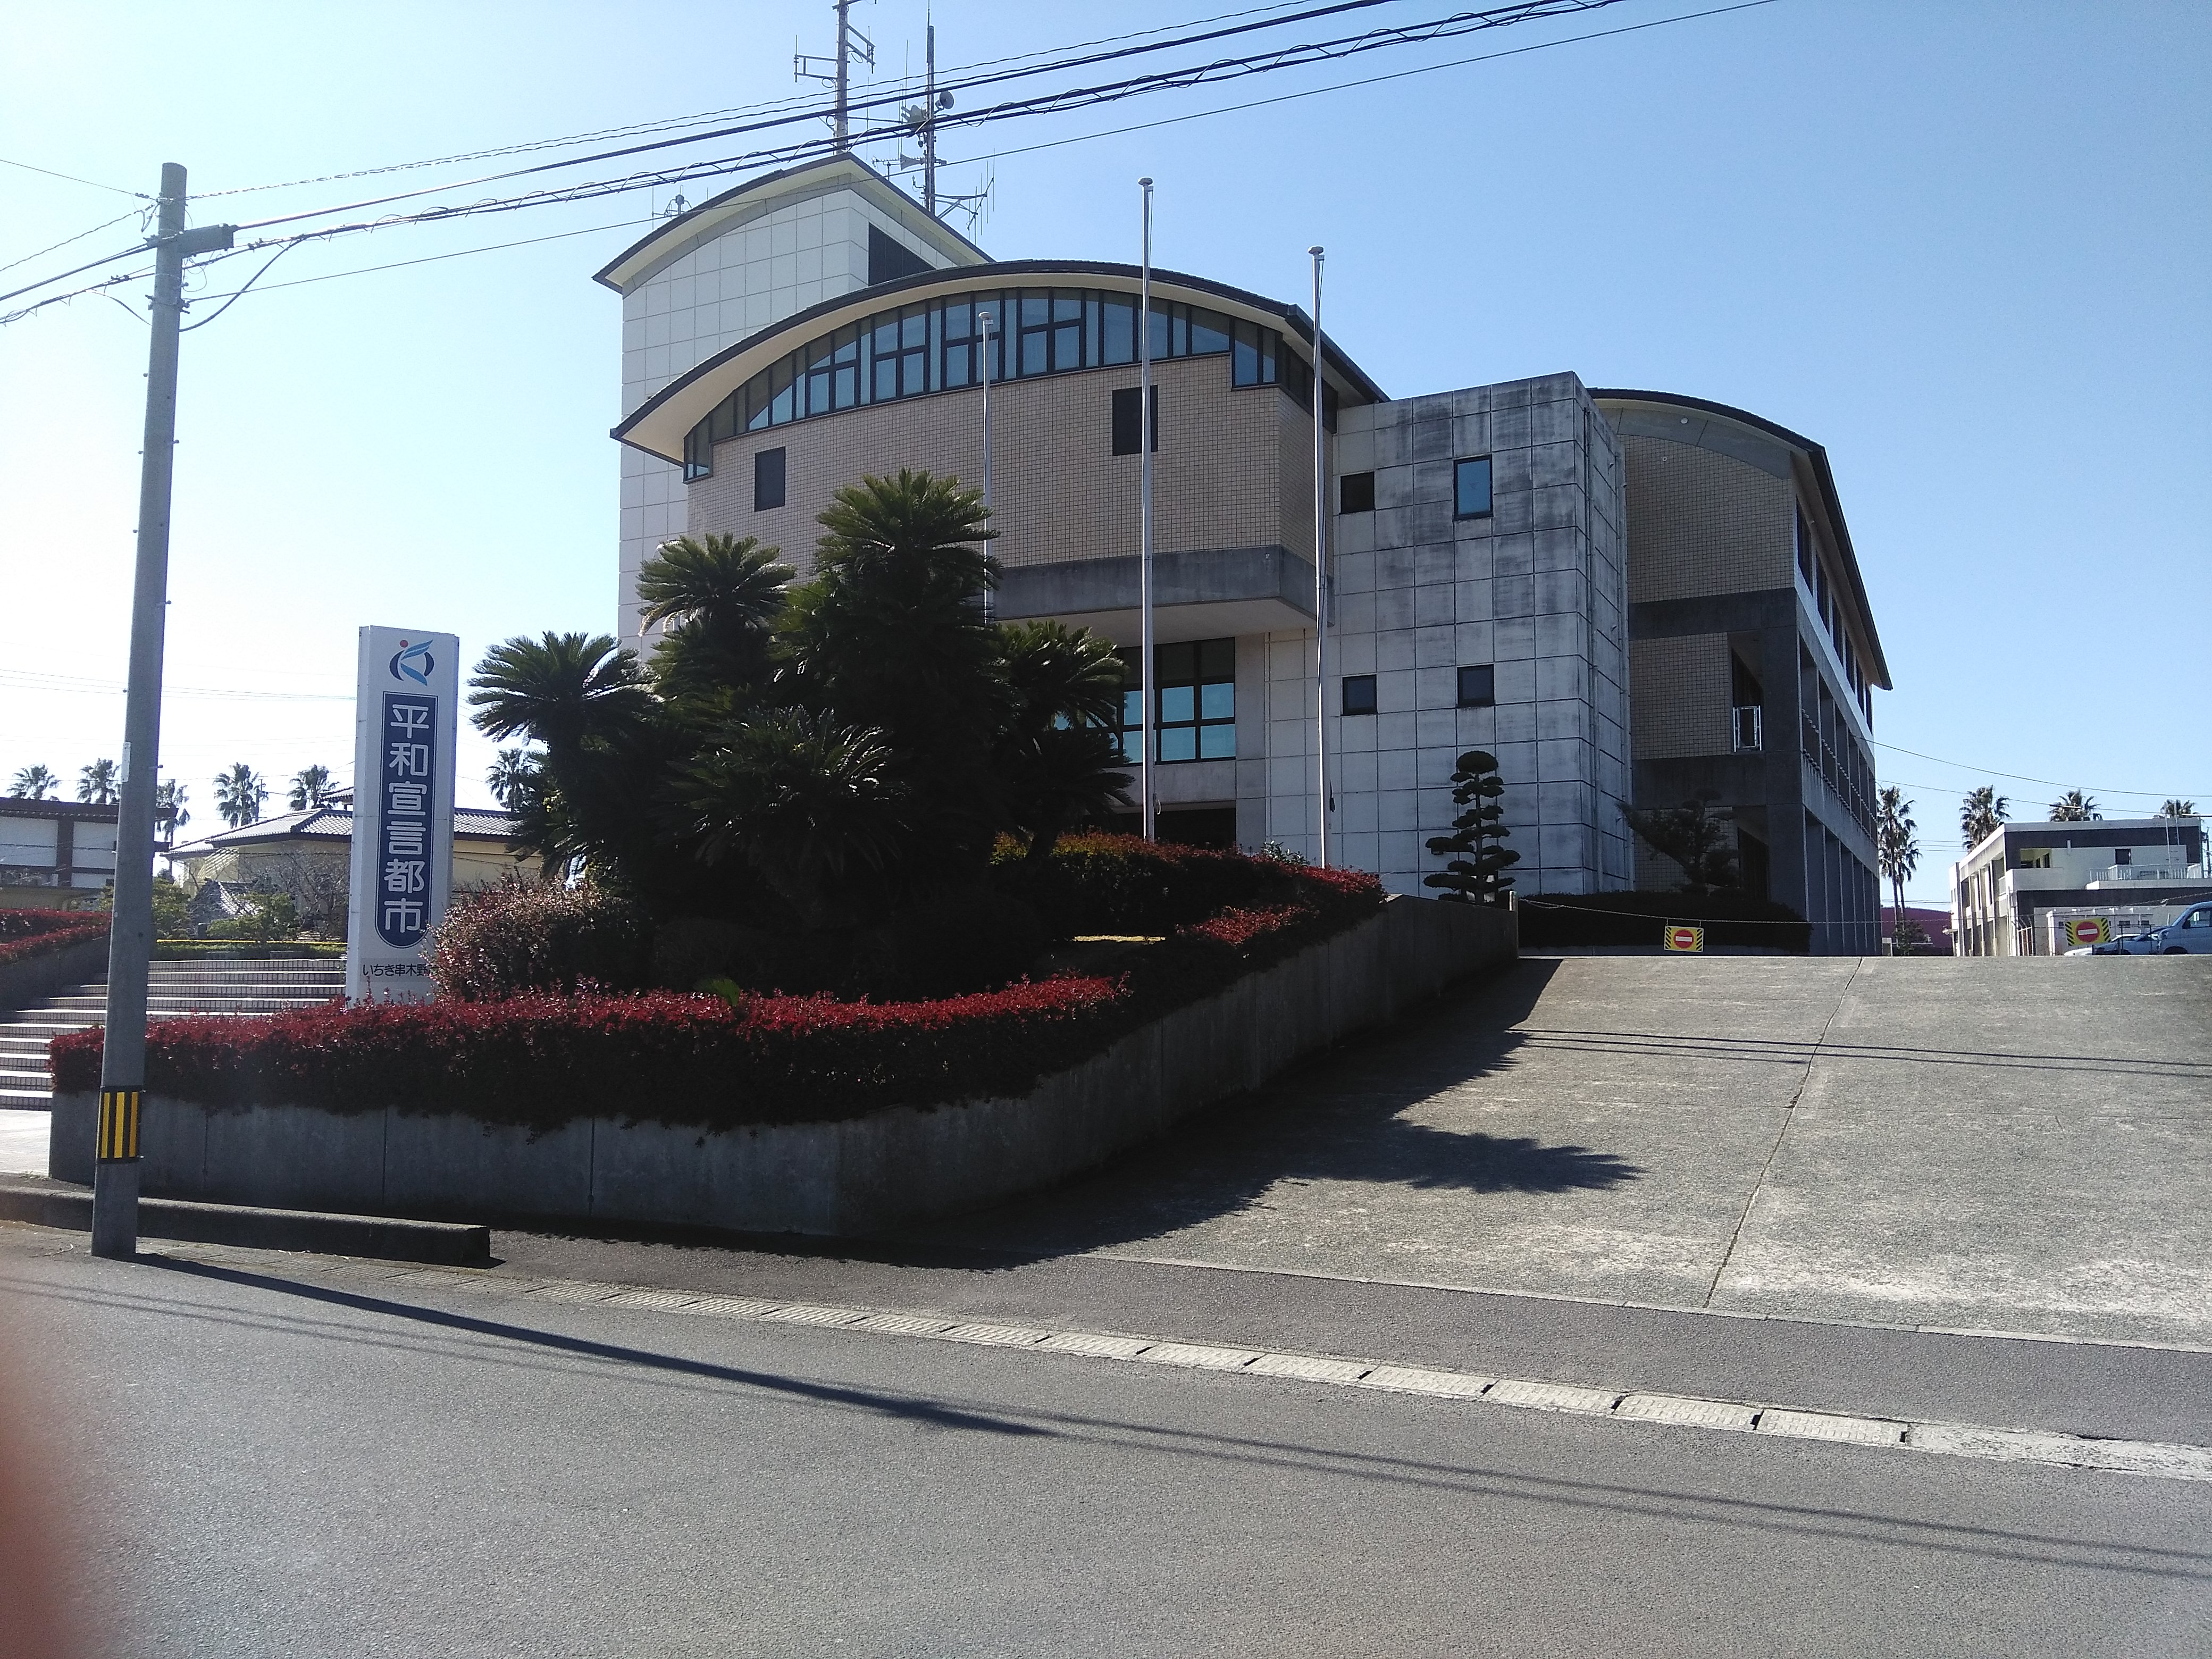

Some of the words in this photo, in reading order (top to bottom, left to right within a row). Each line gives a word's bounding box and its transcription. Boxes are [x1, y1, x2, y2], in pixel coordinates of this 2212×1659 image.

[383, 703, 430, 934] 平和宣言都市
